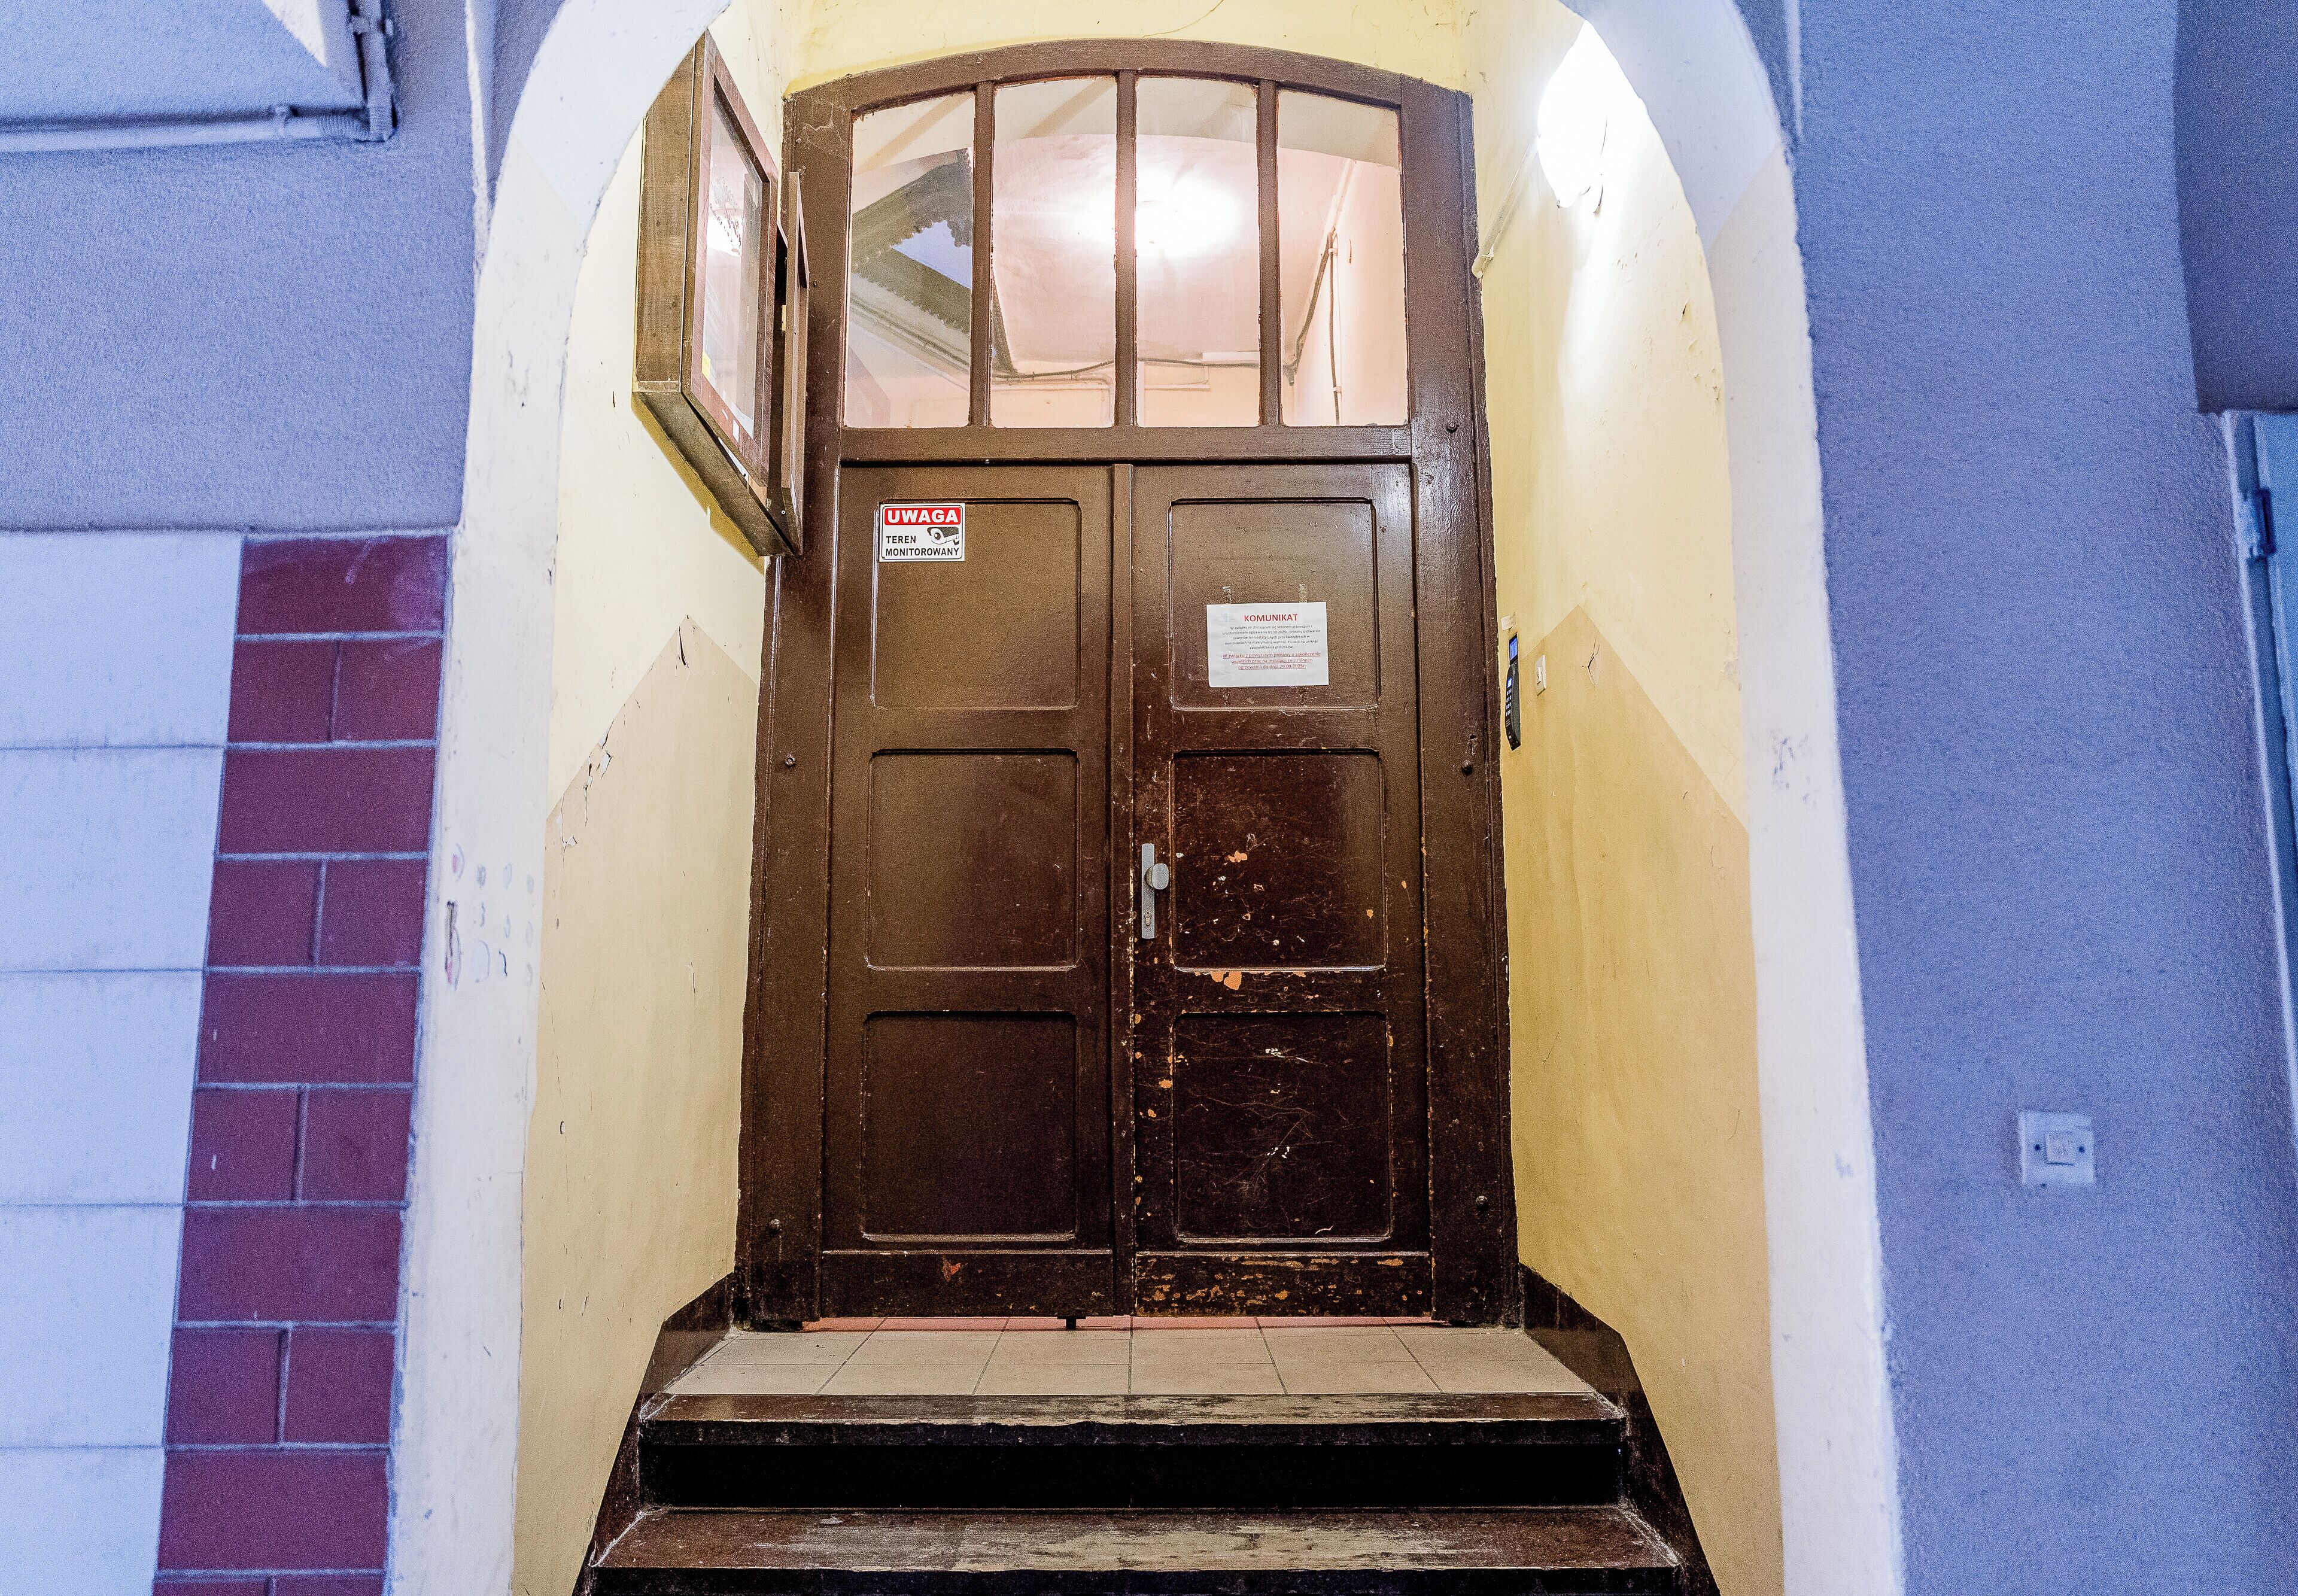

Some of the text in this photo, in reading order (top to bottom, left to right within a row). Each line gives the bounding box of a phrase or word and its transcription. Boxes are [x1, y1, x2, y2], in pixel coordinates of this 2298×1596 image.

[887, 509, 958, 523] UWAGA
[886, 535, 916, 544] TEREN
[886, 548, 959, 557] MONITOROWANY
